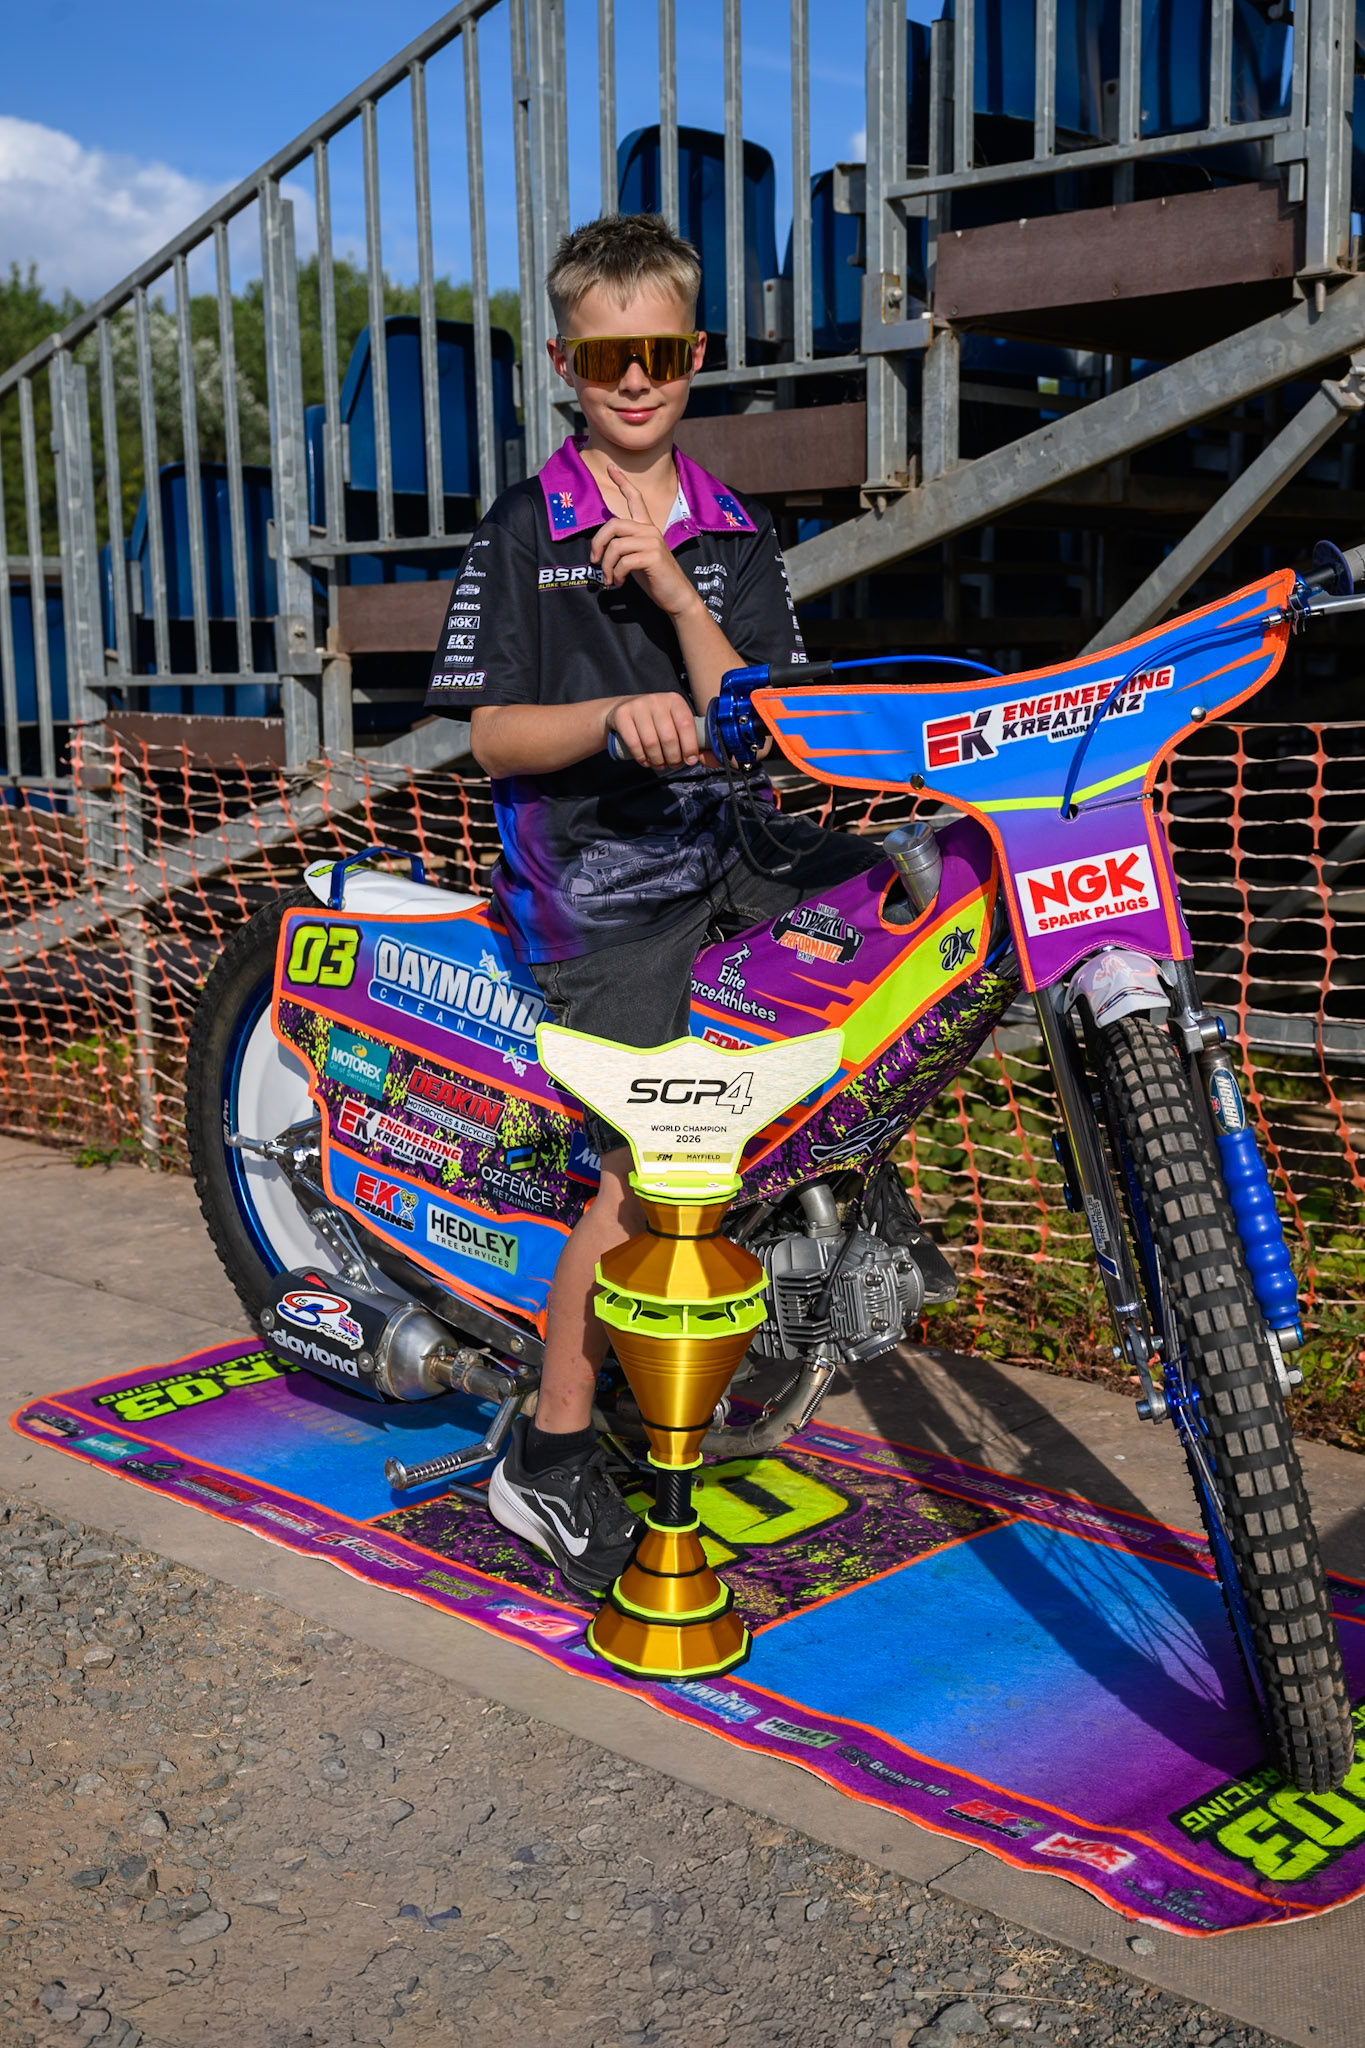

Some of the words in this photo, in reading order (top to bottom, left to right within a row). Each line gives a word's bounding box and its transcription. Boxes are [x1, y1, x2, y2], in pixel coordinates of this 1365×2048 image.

[451, 602, 481, 612] Mitas
[447, 634, 468, 645] EK
[444, 655, 475, 663] DEAKIN
[431, 672, 485, 687] BSR03
[926, 709, 995, 768] EK
[1027, 852, 1145, 915] NGK
[1037, 909, 1092, 931] SPARK
[1094, 896, 1149, 918] PLUGS
[286, 924, 361, 989] 03
[778, 931, 843, 963] PERFORMANCE
[377, 940, 545, 1037] DAYMOND
[717, 964, 746, 991] Elite
[691, 979, 777, 1022] orceAthletes
[379, 987, 528, 1056] CLEANING
[329, 1061, 338, 1071] Oil
[339, 1066, 345, 1075] of
[346, 1069, 380, 1091] Switzerland
[330, 1046, 382, 1082] MOTOREX
[408, 1068, 502, 1127] DEAKIN
[339, 1099, 376, 1141] EK
[407, 1100, 453, 1127] MOTORCYCLES
[453, 1120, 459, 1128] &
[460, 1122, 496, 1143] BICYCLES
[650, 1124, 681, 1132] WORLD
[683, 1124, 727, 1133] CHAMPION
[373, 1127, 445, 1166] KREATIONZ
[378, 1116, 461, 1161] ENGINEERING
[675, 1134, 702, 1143] 2026
[656, 1153, 673, 1161] FIM
[355, 1172, 401, 1211] EK
[481, 1165, 554, 1207] OZFENCE
[492, 1188, 543, 1213] RETAINING
[354, 1198, 415, 1232] CHAINS
[1086, 1196, 1097, 1223] PLUS
[1093, 1200, 1107, 1241] FRAMES
[431, 1209, 516, 1258] HEDLEY
[436, 1234, 459, 1250] TREE
[461, 1246, 510, 1269] SERVICES
[318, 1321, 360, 1347] Racing
[273, 1328, 360, 1379] daytona
[98, 1374, 193, 1406] RACING
[114, 1359, 286, 1422] R03
[768, 1718, 839, 1744] HEDLEY
[868, 1759, 925, 1789] Benham
[951, 1799, 1023, 1825] EK
[1179, 1766, 1283, 1834] RACING
[1050, 1835, 1128, 1865] NGK
